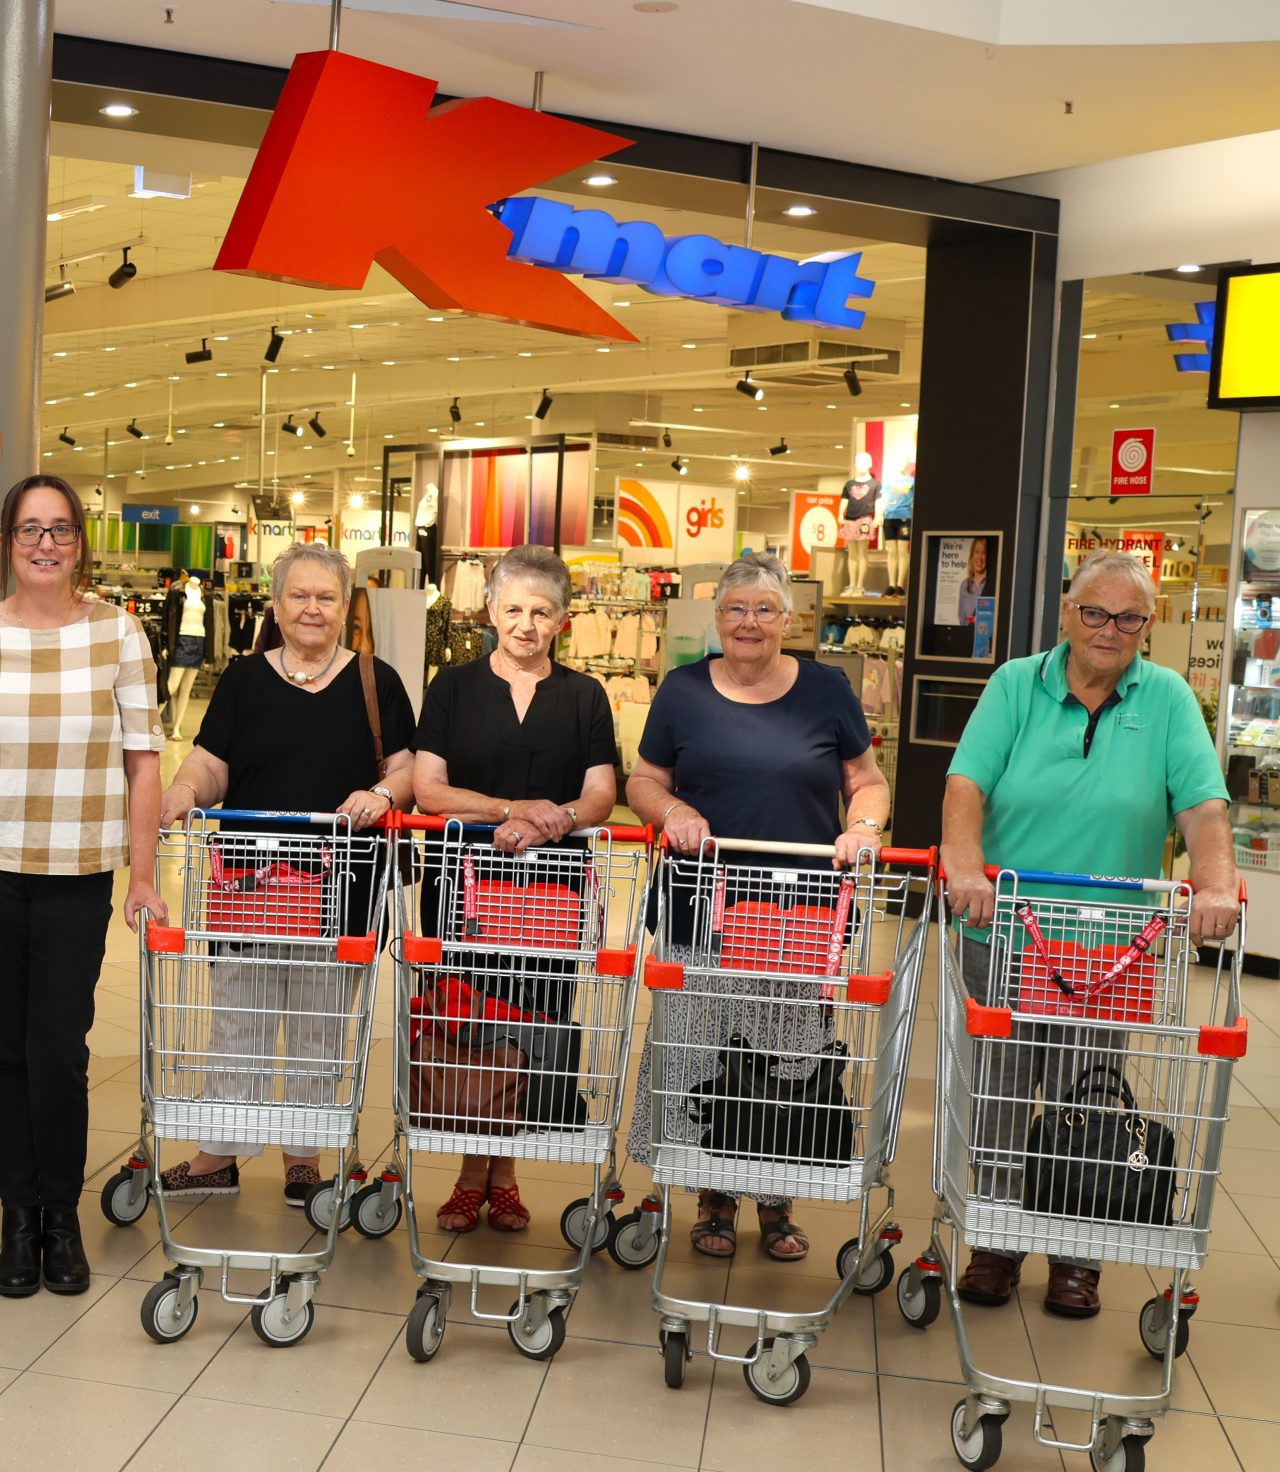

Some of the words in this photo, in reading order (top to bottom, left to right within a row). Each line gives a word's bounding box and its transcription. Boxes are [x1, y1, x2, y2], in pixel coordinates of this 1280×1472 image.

[1113, 476, 1128, 485] FIRE
[1129, 476, 1148, 485] HOSE
[141, 509, 160, 520] exit
[686, 497, 724, 538] girls
[1068, 538, 1096, 550] FIRE
[1100, 539, 1162, 551] HYDRANT
[942, 551, 960, 559] here
[951, 560, 968, 570] help
